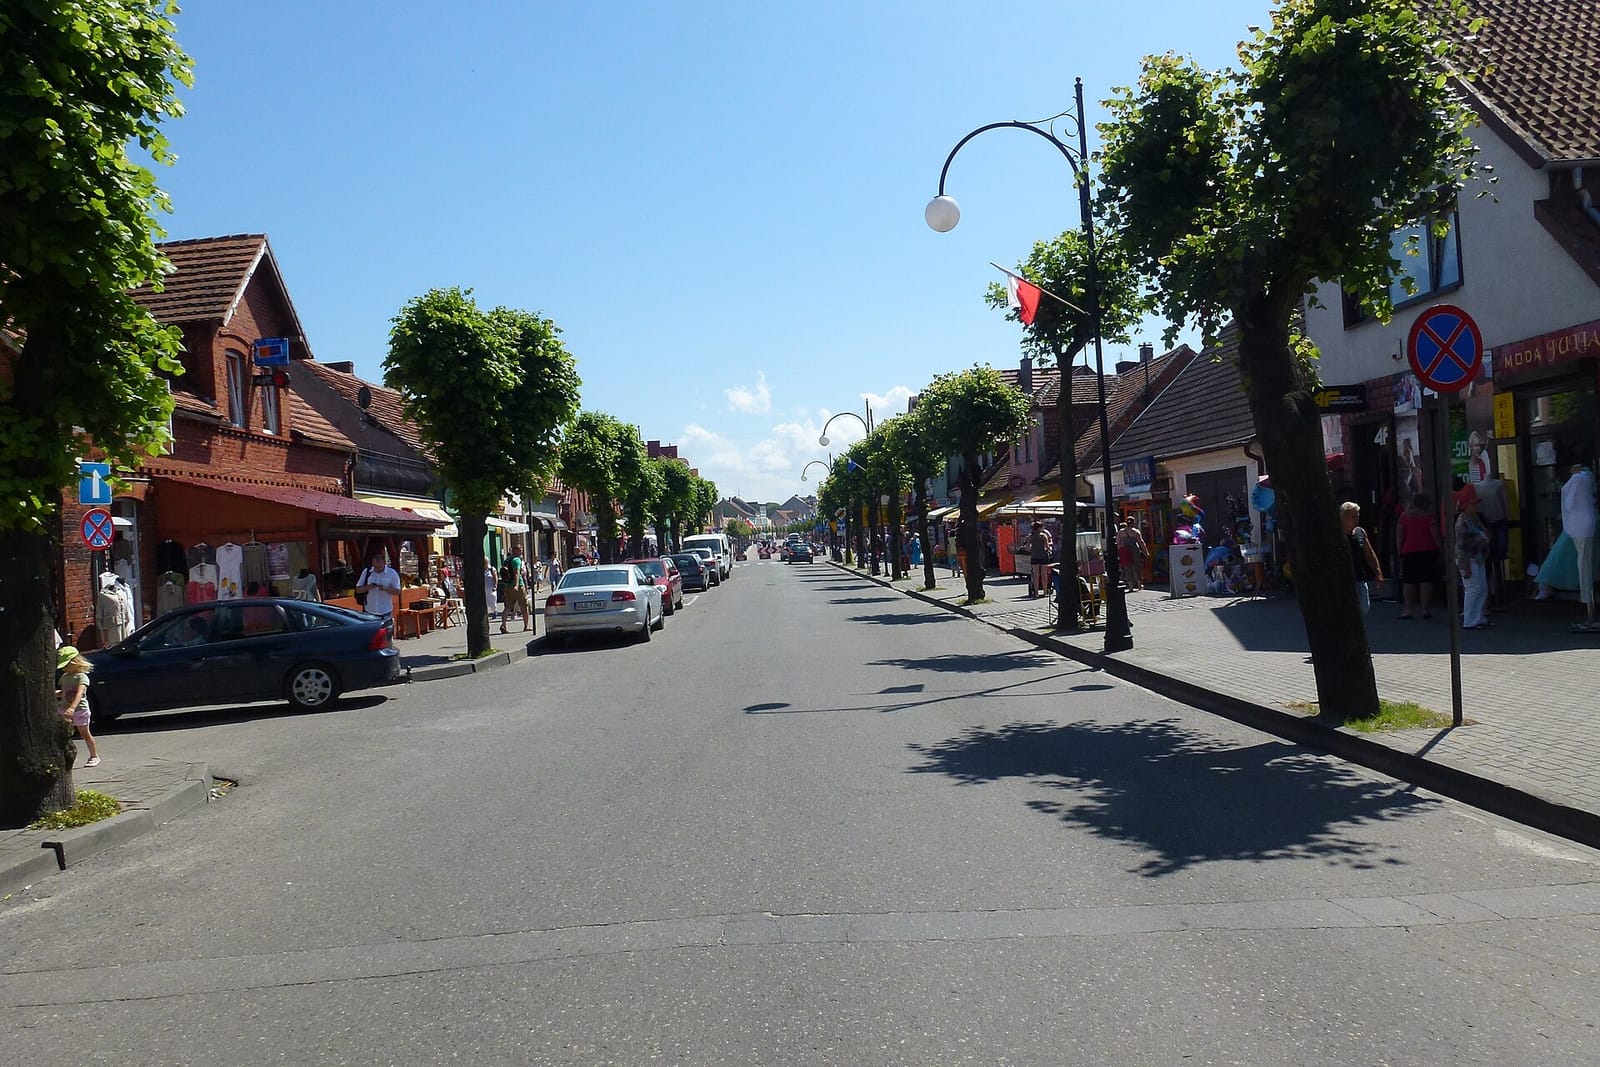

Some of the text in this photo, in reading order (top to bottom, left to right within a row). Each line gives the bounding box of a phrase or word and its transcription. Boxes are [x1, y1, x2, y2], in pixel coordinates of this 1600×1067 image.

[1504, 348, 1542, 368] MODA
[1314, 391, 1341, 408] 4F
[1373, 426, 1389, 446] 4F
